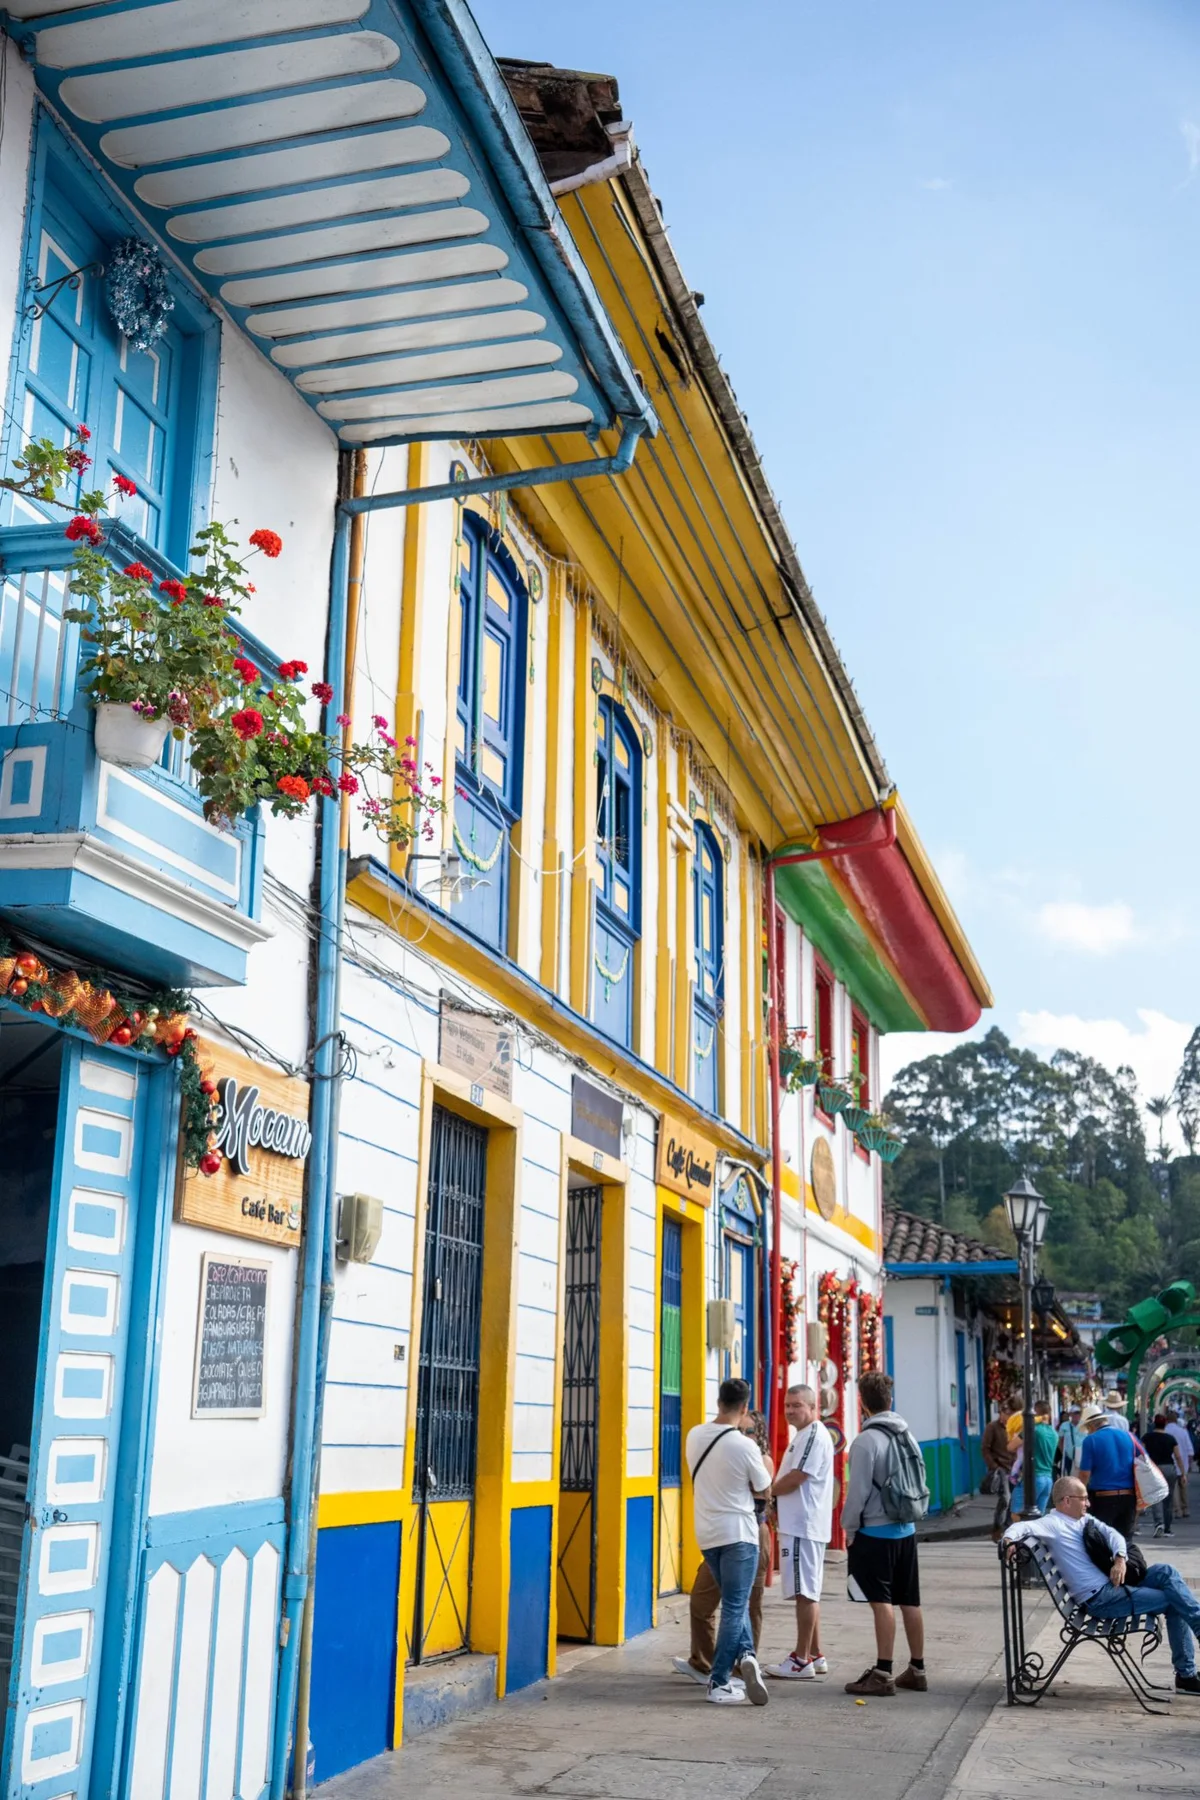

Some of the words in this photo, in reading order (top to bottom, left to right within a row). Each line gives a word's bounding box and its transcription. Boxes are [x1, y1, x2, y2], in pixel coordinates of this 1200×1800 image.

[667, 1137, 685, 1179] Café
[241, 1196, 266, 1221] Café
[267, 1203, 286, 1225] Bar
[202, 1341, 225, 1358] JUGOS
[237, 1361, 262, 1378] QUESO
